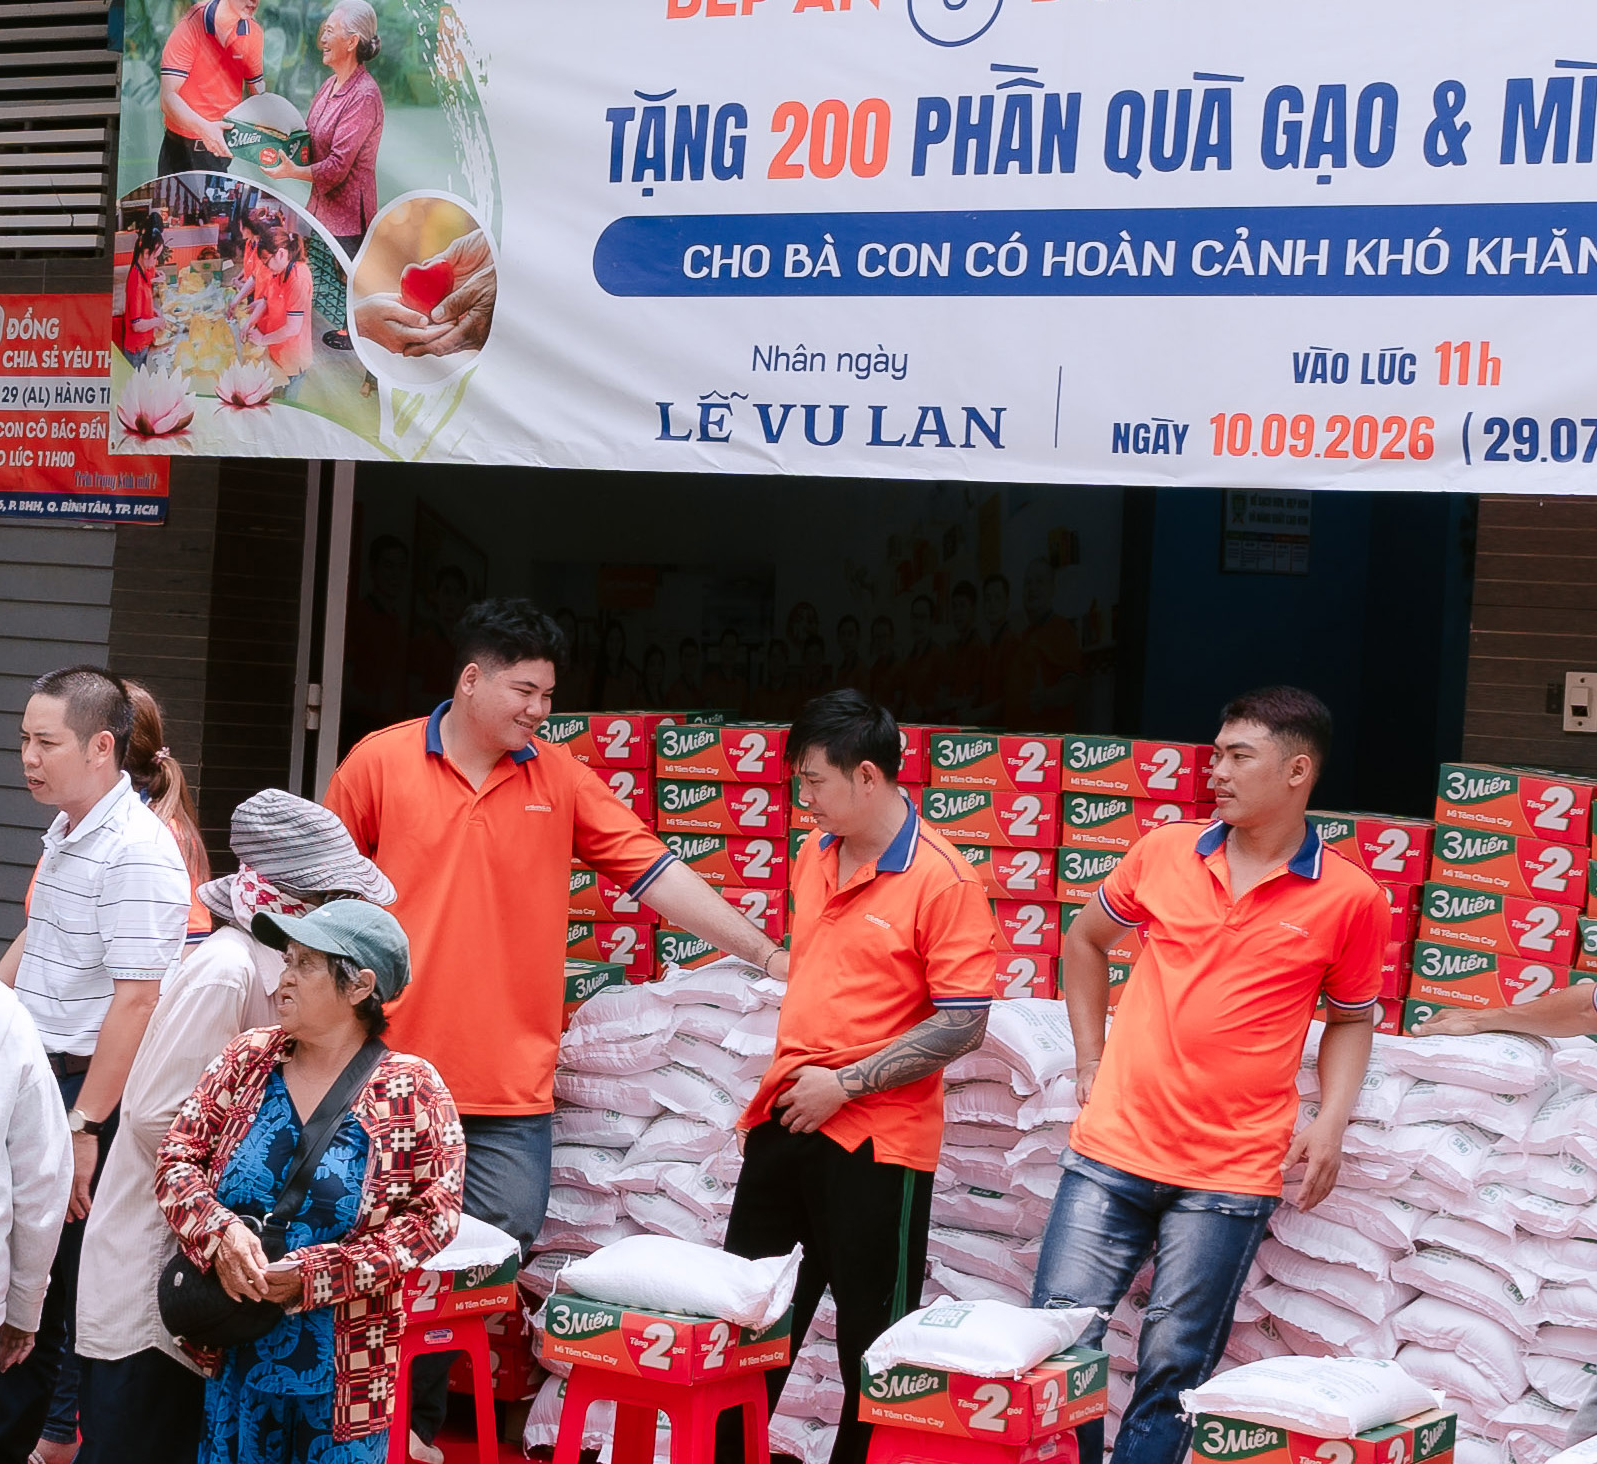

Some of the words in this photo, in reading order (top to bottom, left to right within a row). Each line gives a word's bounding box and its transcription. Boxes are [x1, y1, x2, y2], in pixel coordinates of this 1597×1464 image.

[606, 89, 747, 196] TẶNG
[768, 98, 890, 179] 200
[912, 64, 1081, 176] PHẦN
[1105, 72, 1243, 179] QUÀ
[1261, 82, 1398, 184] GẠO
[1424, 80, 1471, 167] &
[684, 245, 770, 278] CHO
[785, 234, 840, 277] BÀ
[858, 243, 950, 277] CON
[966, 232, 1027, 277] CÓ
[1043, 231, 1175, 276] HOÀN
[1192, 227, 1329, 276] CẢNH
[1345, 227, 1449, 275] KHÓ
[6, 307, 60, 340] ĐỒNG
[3, 351, 38, 368] CHIA
[41, 345, 59, 368] SẺ
[62, 345, 93, 368] YÊU
[752, 343, 826, 372] Nhân
[837, 343, 908, 380] ngày
[1294, 347, 1348, 383] VÀO
[1362, 348, 1416, 384] LÚC
[1436, 341, 1500, 385] 11h
[1, 386, 18, 403] 29
[22, 386, 51, 407] (AL)
[55, 382, 96, 405] HÀNG
[26, 417, 47, 438] CÔ
[51, 418, 75, 439] BÁC
[79, 416, 106, 439] ĐẾN
[654, 388, 749, 446] LỄ
[753, 403, 849, 447] VU
[866, 403, 1009, 452] LAN
[1113, 418, 1188, 454] NGÀY
[1211, 413, 1434, 460] 10.09.2026
[9, 449, 34, 467] LÚC
[37, 451, 75, 467] 11H00
[8, 501, 17, 510] P.
[47, 502, 59, 511] Q.
[115, 503, 131, 515] TP.
[134, 504, 159, 515] HCM
